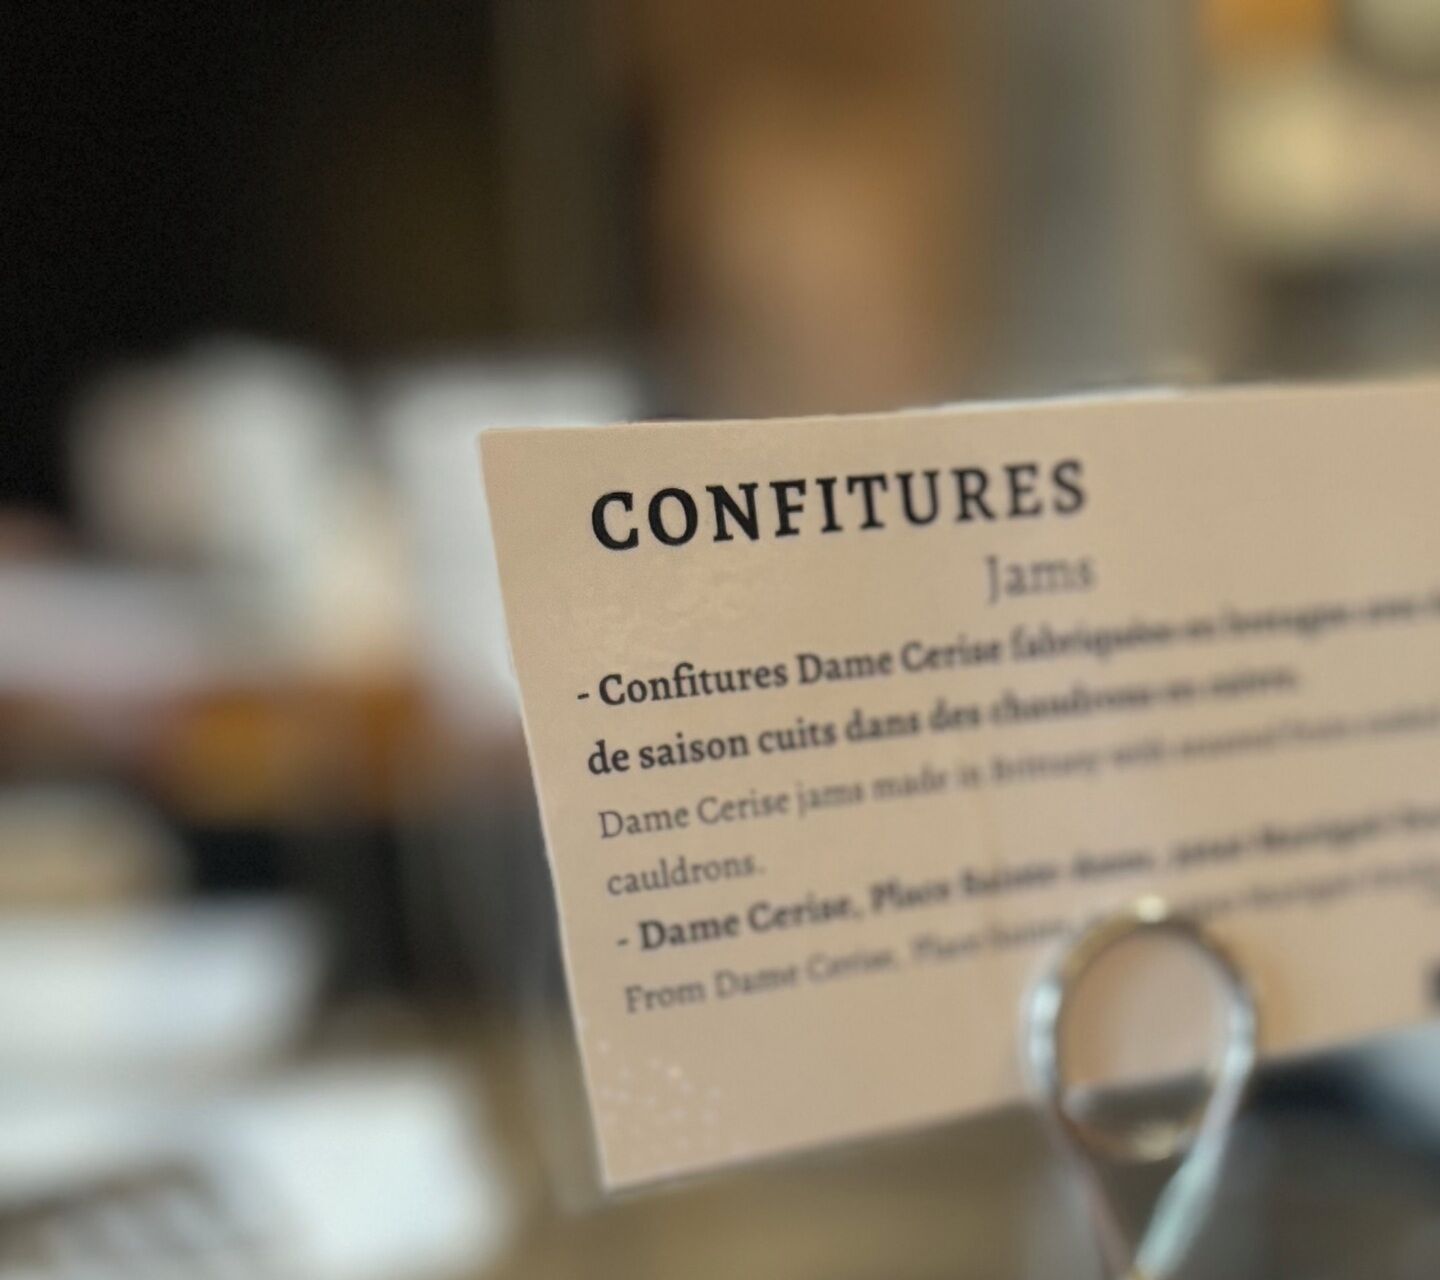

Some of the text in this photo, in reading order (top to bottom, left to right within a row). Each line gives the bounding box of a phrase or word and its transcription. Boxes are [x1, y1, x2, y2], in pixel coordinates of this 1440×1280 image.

[591, 459, 1086, 551] CONFITURES
[984, 554, 1096, 603] Jams
[598, 662, 788, 707] Confitures
[796, 649, 893, 687] Dame
[901, 638, 1000, 674] Cerise
[588, 739, 630, 777] de
[639, 731, 750, 770] saison
[758, 716, 838, 757] cuits
[846, 709, 922, 744] dans
[598, 802, 690, 839] Dame
[697, 789, 790, 826] Cerise
[796, 780, 863, 817] jams
[606, 852, 766, 896] cauldrons.
[638, 913, 741, 951] Dame
[624, 981, 706, 1014] From
[714, 966, 798, 1000] Dame
